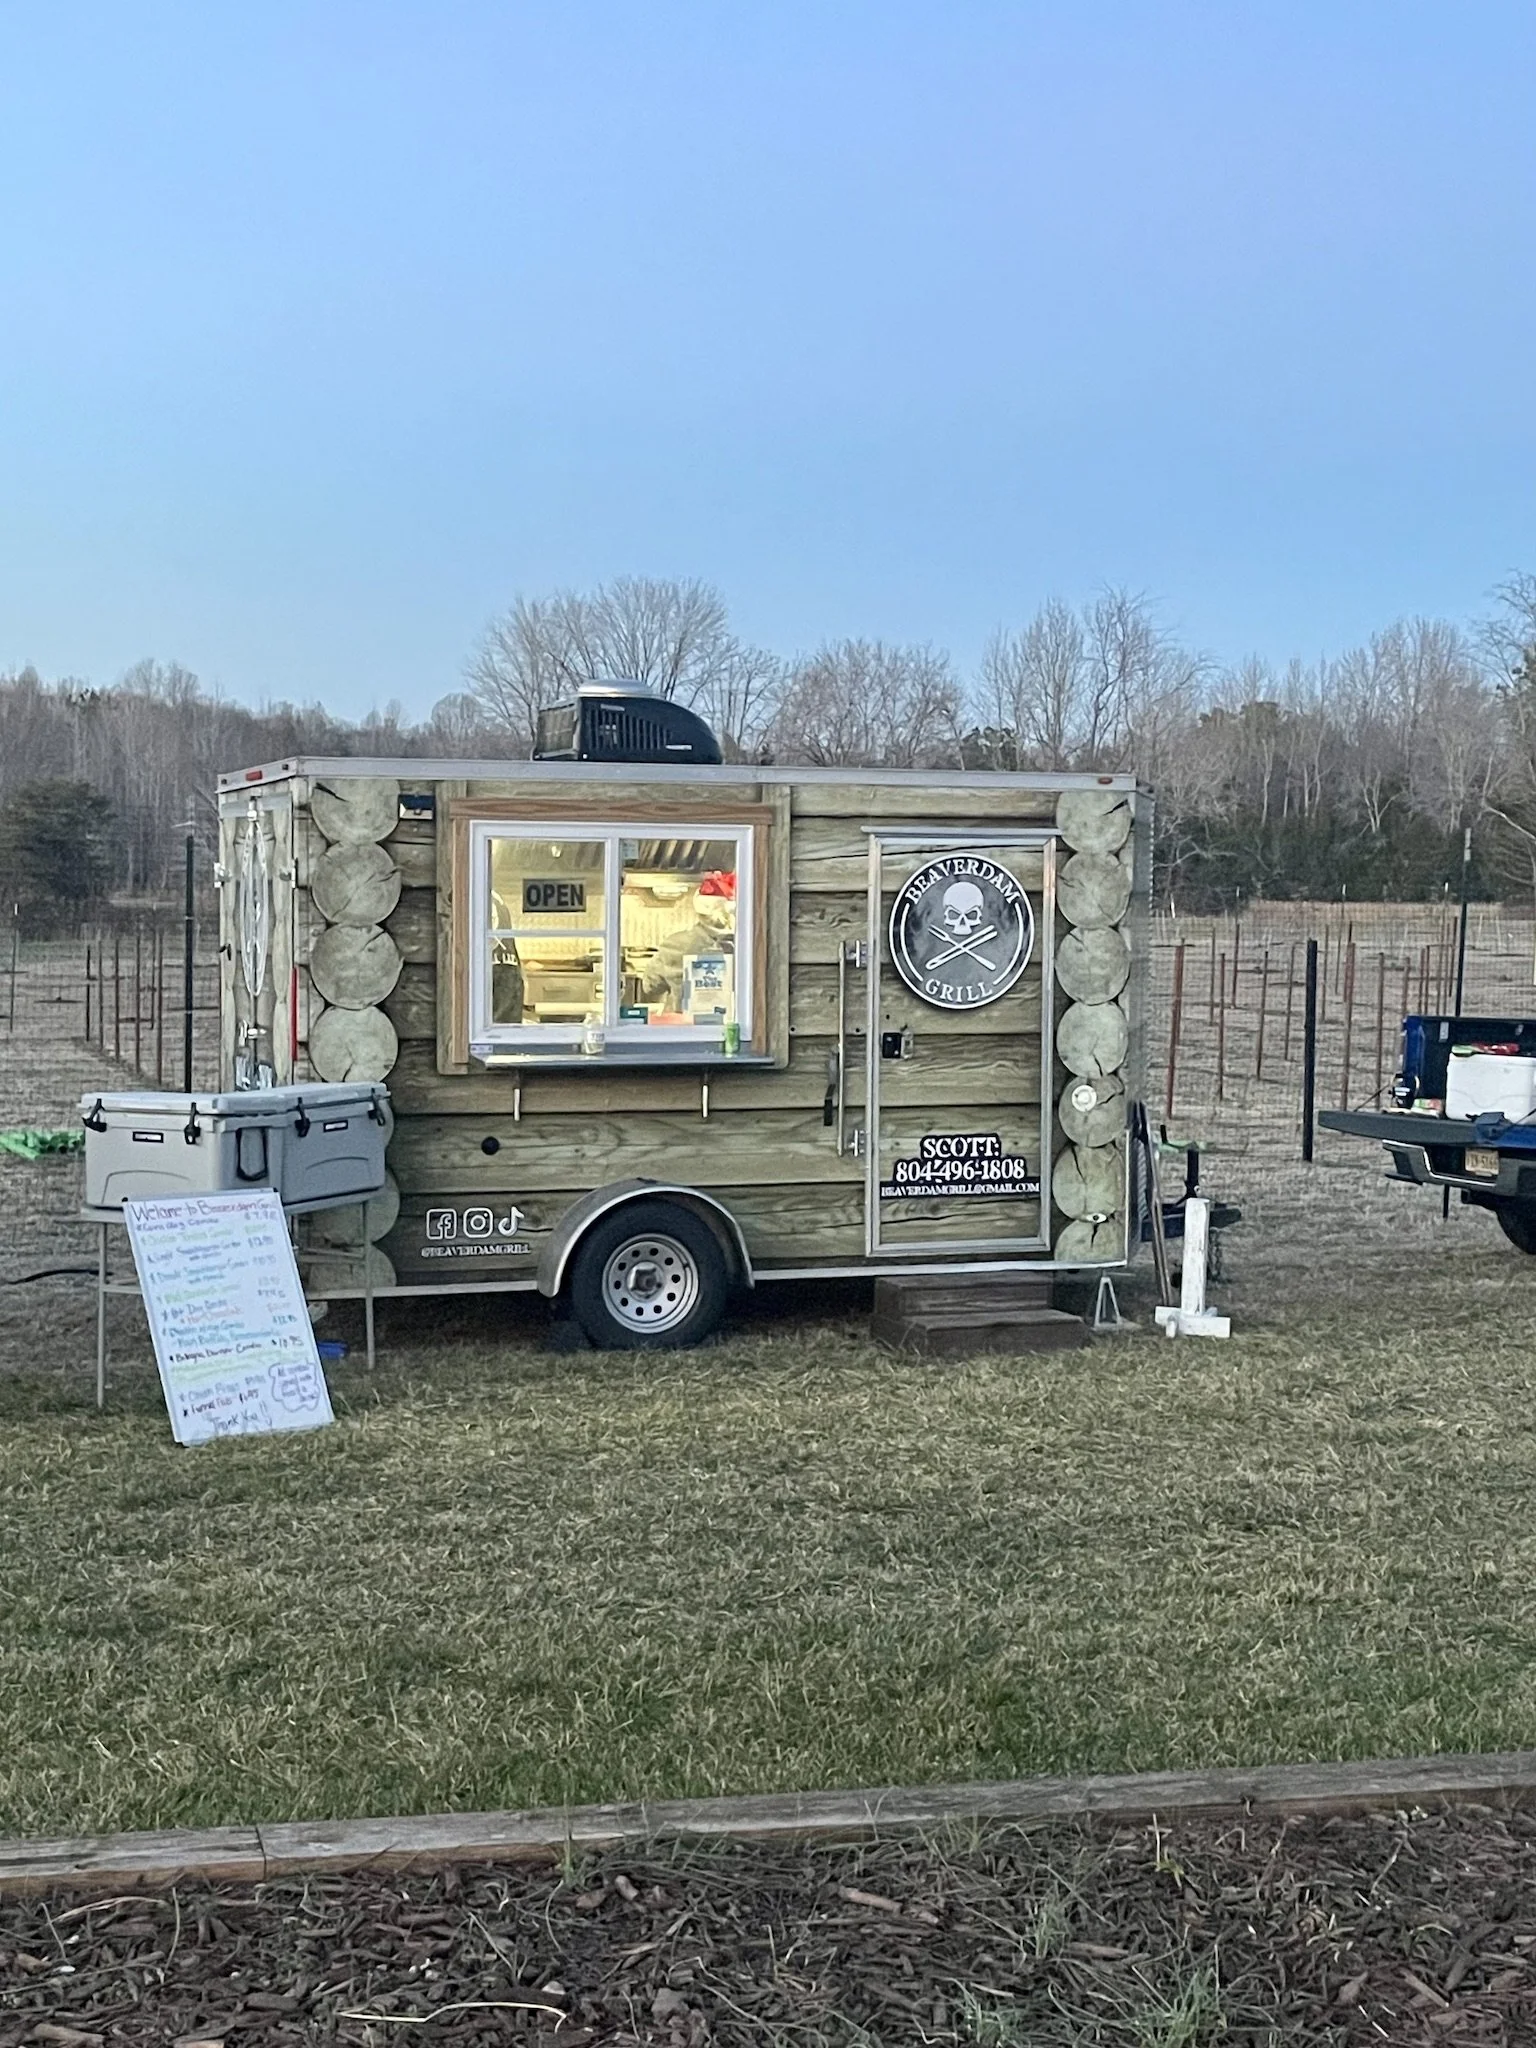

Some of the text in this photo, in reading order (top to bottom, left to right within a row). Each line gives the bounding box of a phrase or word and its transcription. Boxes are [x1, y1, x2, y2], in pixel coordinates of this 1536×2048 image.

[905, 858, 1020, 904] BEAVERDAM
[526, 883, 584, 907] OPEN
[925, 978, 992, 1002] GRILL
[923, 1136, 999, 1158] SCOTT:
[896, 1158, 1025, 1183] 804-496-1808
[881, 1182, 1039, 1197] BEAVERDAMGRILL@GMAIL.COM
[421, 1243, 531, 1258] @BEAVERDAMGRILL
